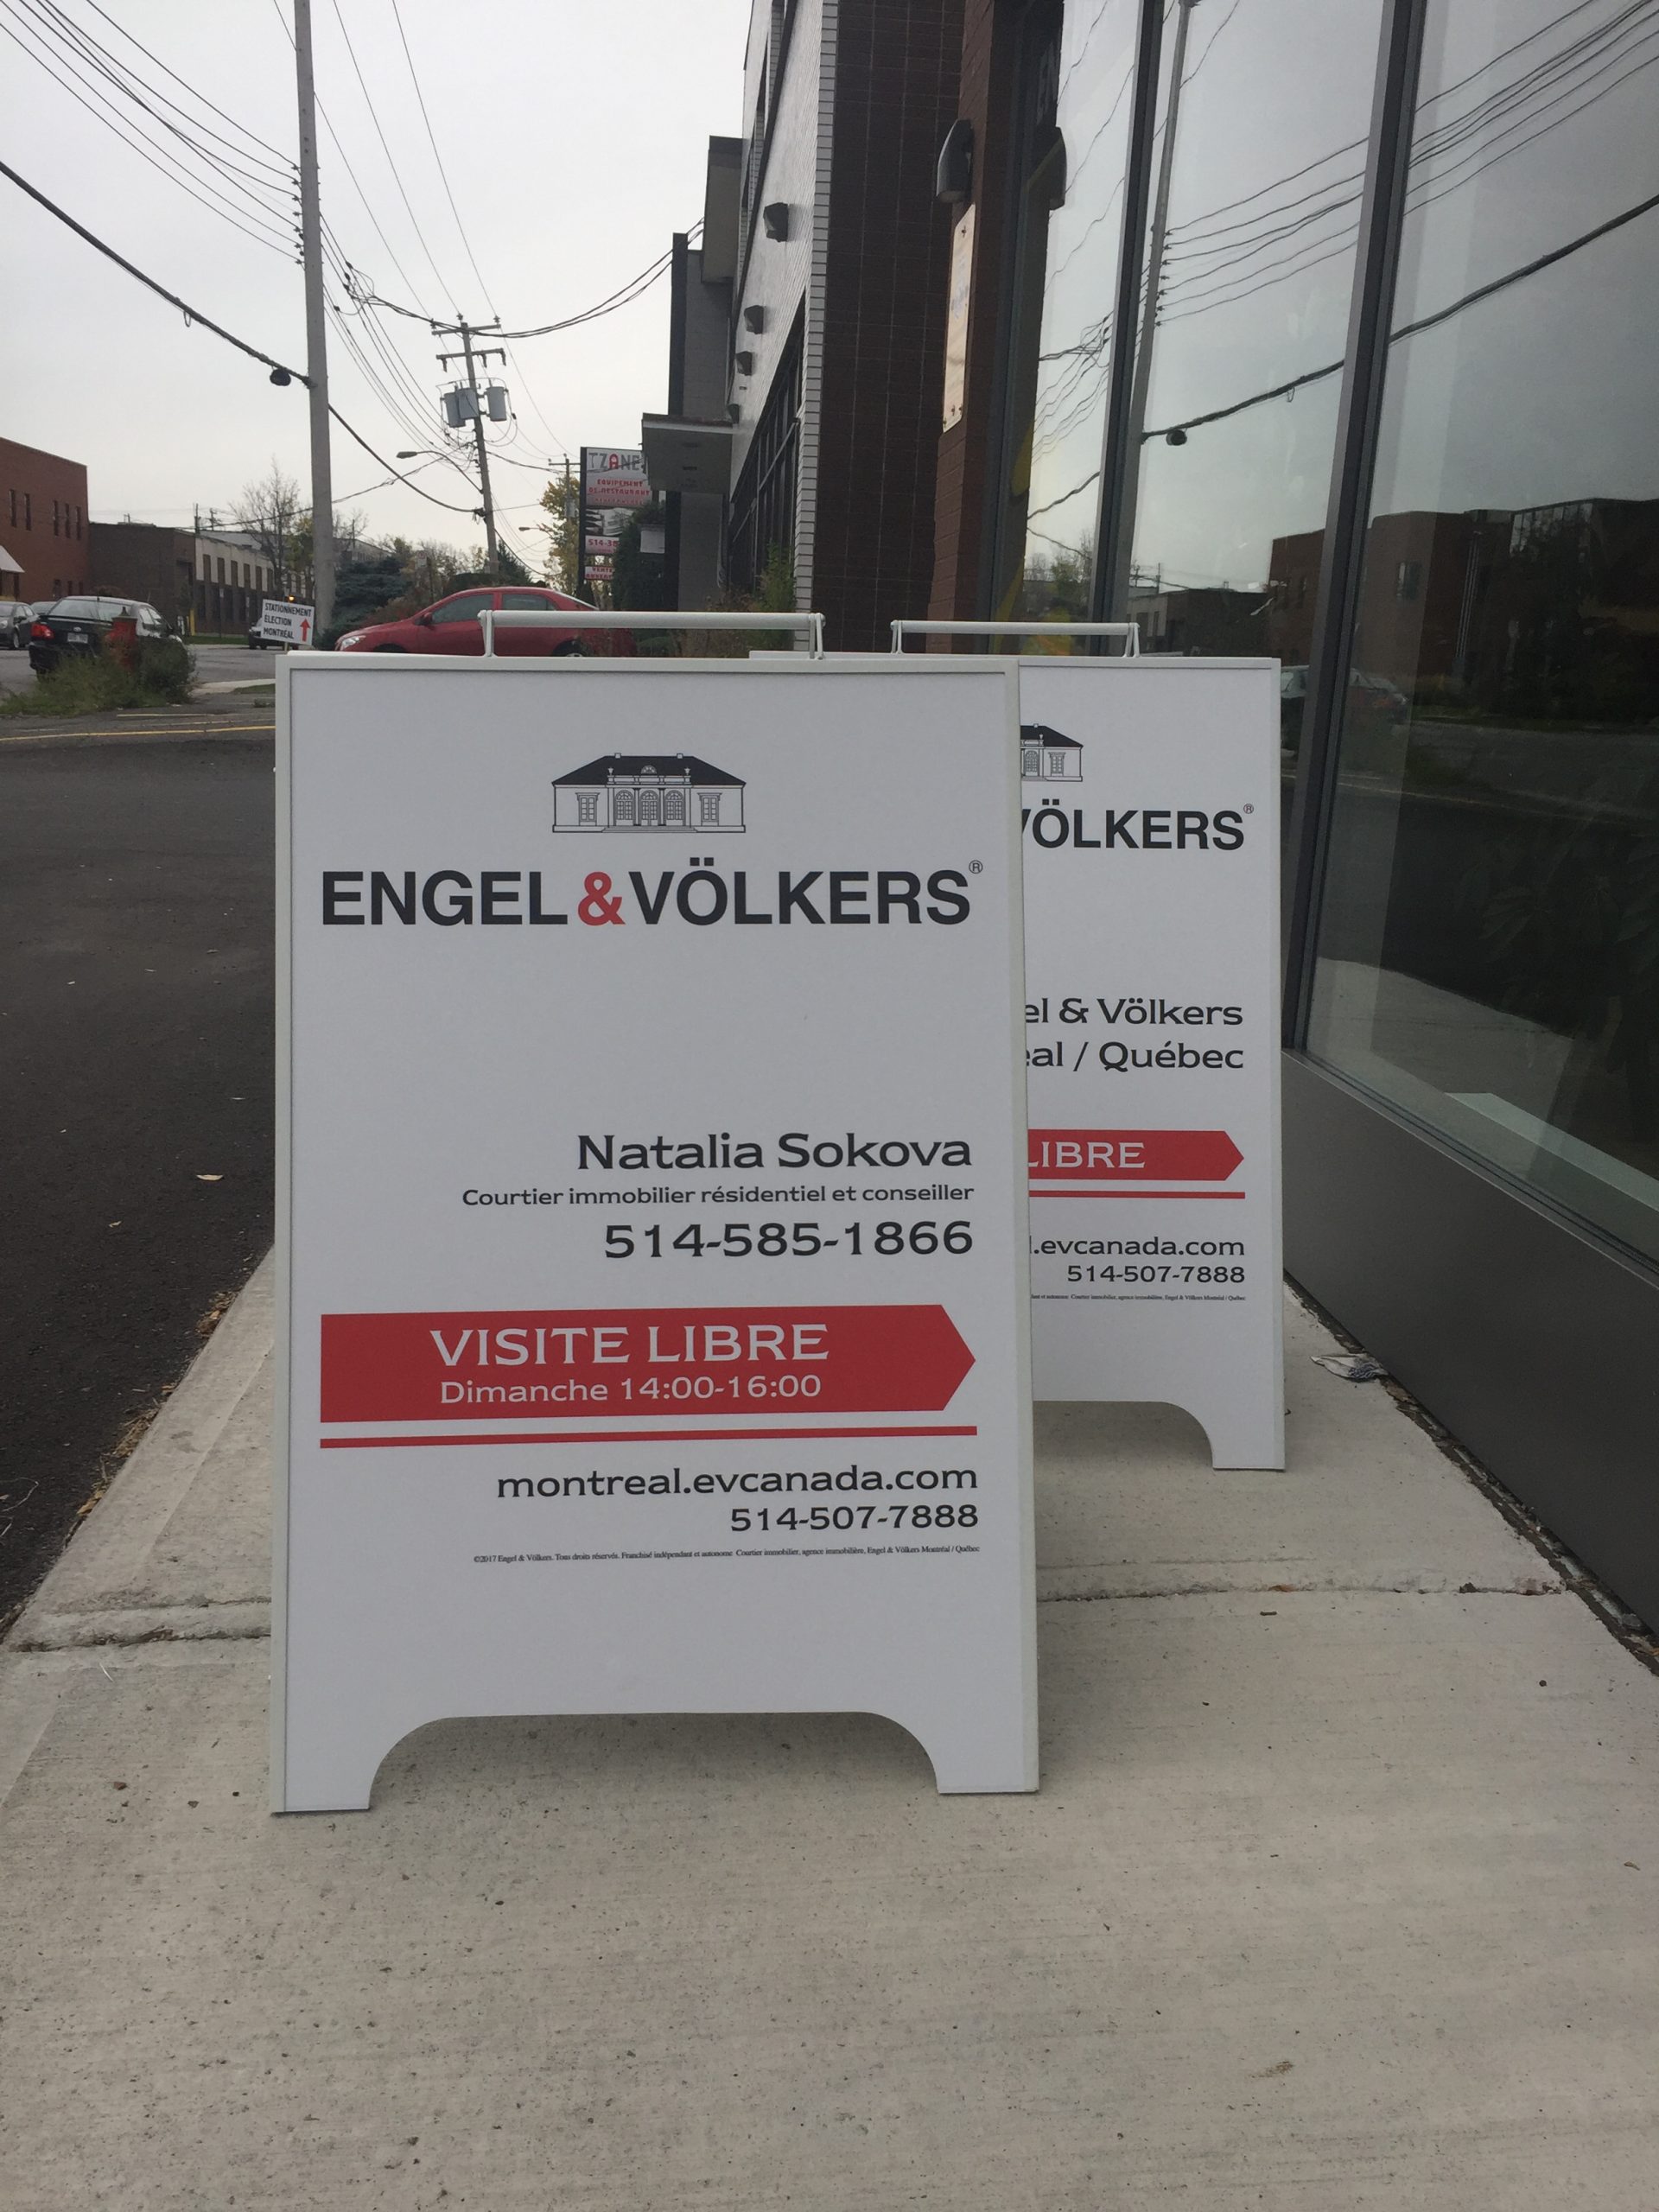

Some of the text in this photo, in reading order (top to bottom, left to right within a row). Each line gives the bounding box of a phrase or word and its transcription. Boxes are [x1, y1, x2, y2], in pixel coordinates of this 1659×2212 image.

[265, 602, 311, 617] STATIONNEMENT
[1058, 998, 1090, 1023] &
[1096, 998, 1243, 1026] Völkers
[1072, 1041, 1089, 1072] /
[1098, 1040, 1244, 1073] Québec
[578, 1133, 973, 1170] Natalia Sokova
[462, 1184, 975, 1206] Courtier immobilier résidentiel et conseiller
[605, 1220, 973, 1259] 514-585-1866
[1067, 1265, 1245, 1284] 514-507-7888
[430, 1325, 830, 1366] VISITE LIBRE
[441, 1374, 821, 1404] Dimanche 14:00-16:00
[498, 1465, 978, 1498] montreal.evcanada.com
[730, 1503, 979, 1532] 514-507-7888
